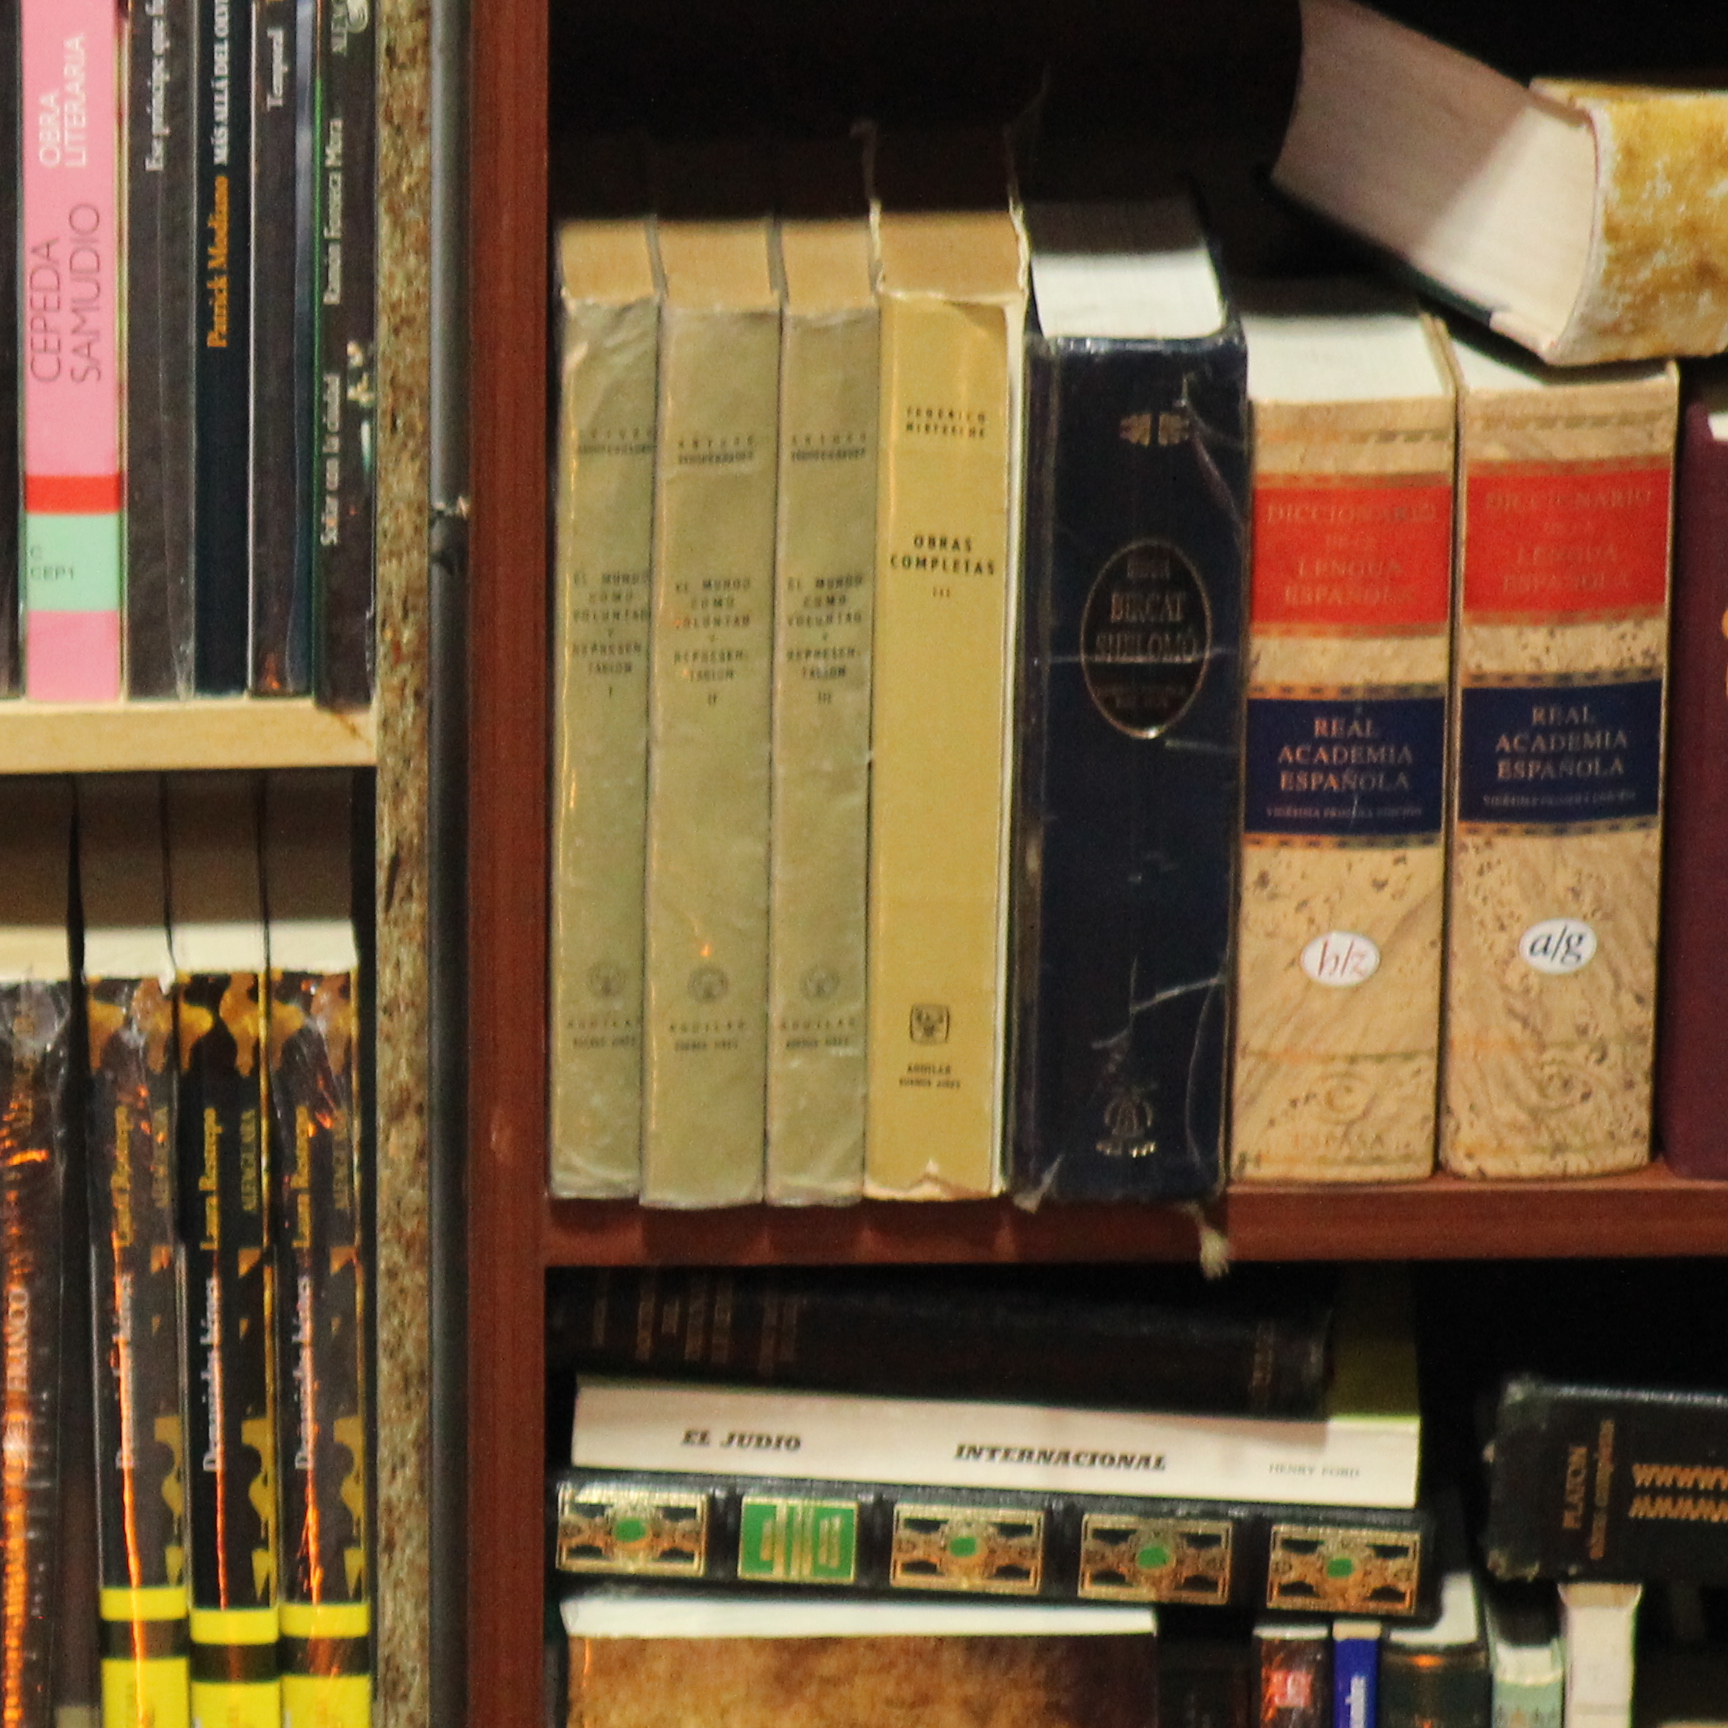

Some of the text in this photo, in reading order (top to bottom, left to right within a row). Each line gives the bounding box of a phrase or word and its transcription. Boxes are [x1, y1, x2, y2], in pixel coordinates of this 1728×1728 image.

[64, 34, 86, 166] LITERARIA
[40, 91, 60, 166] OBRA
[208, 176, 229, 347] Patrick Modiano
[69, 204, 101, 382] SAMUDIO
[31, 237, 61, 382] CEPEDA
[914, 535, 972, 553] OBRAS
[890, 555, 995, 576] COMPLETAS
[1532, 704, 1595, 727] REAL
[1314, 718, 1381, 741] REAL
[1496, 730, 1628, 752] ACADEMIA
[1278, 745, 1413, 766] ACADEMIA
[1498, 755, 1624, 782] ESPAÑOLA
[1280, 766, 1410, 792] ESPAÑOLA
[1529, 925, 1585, 964] a/g
[722, 1433, 802, 1452] JUDIO
[955, 1443, 1168, 1471] INTERNACIONAL
